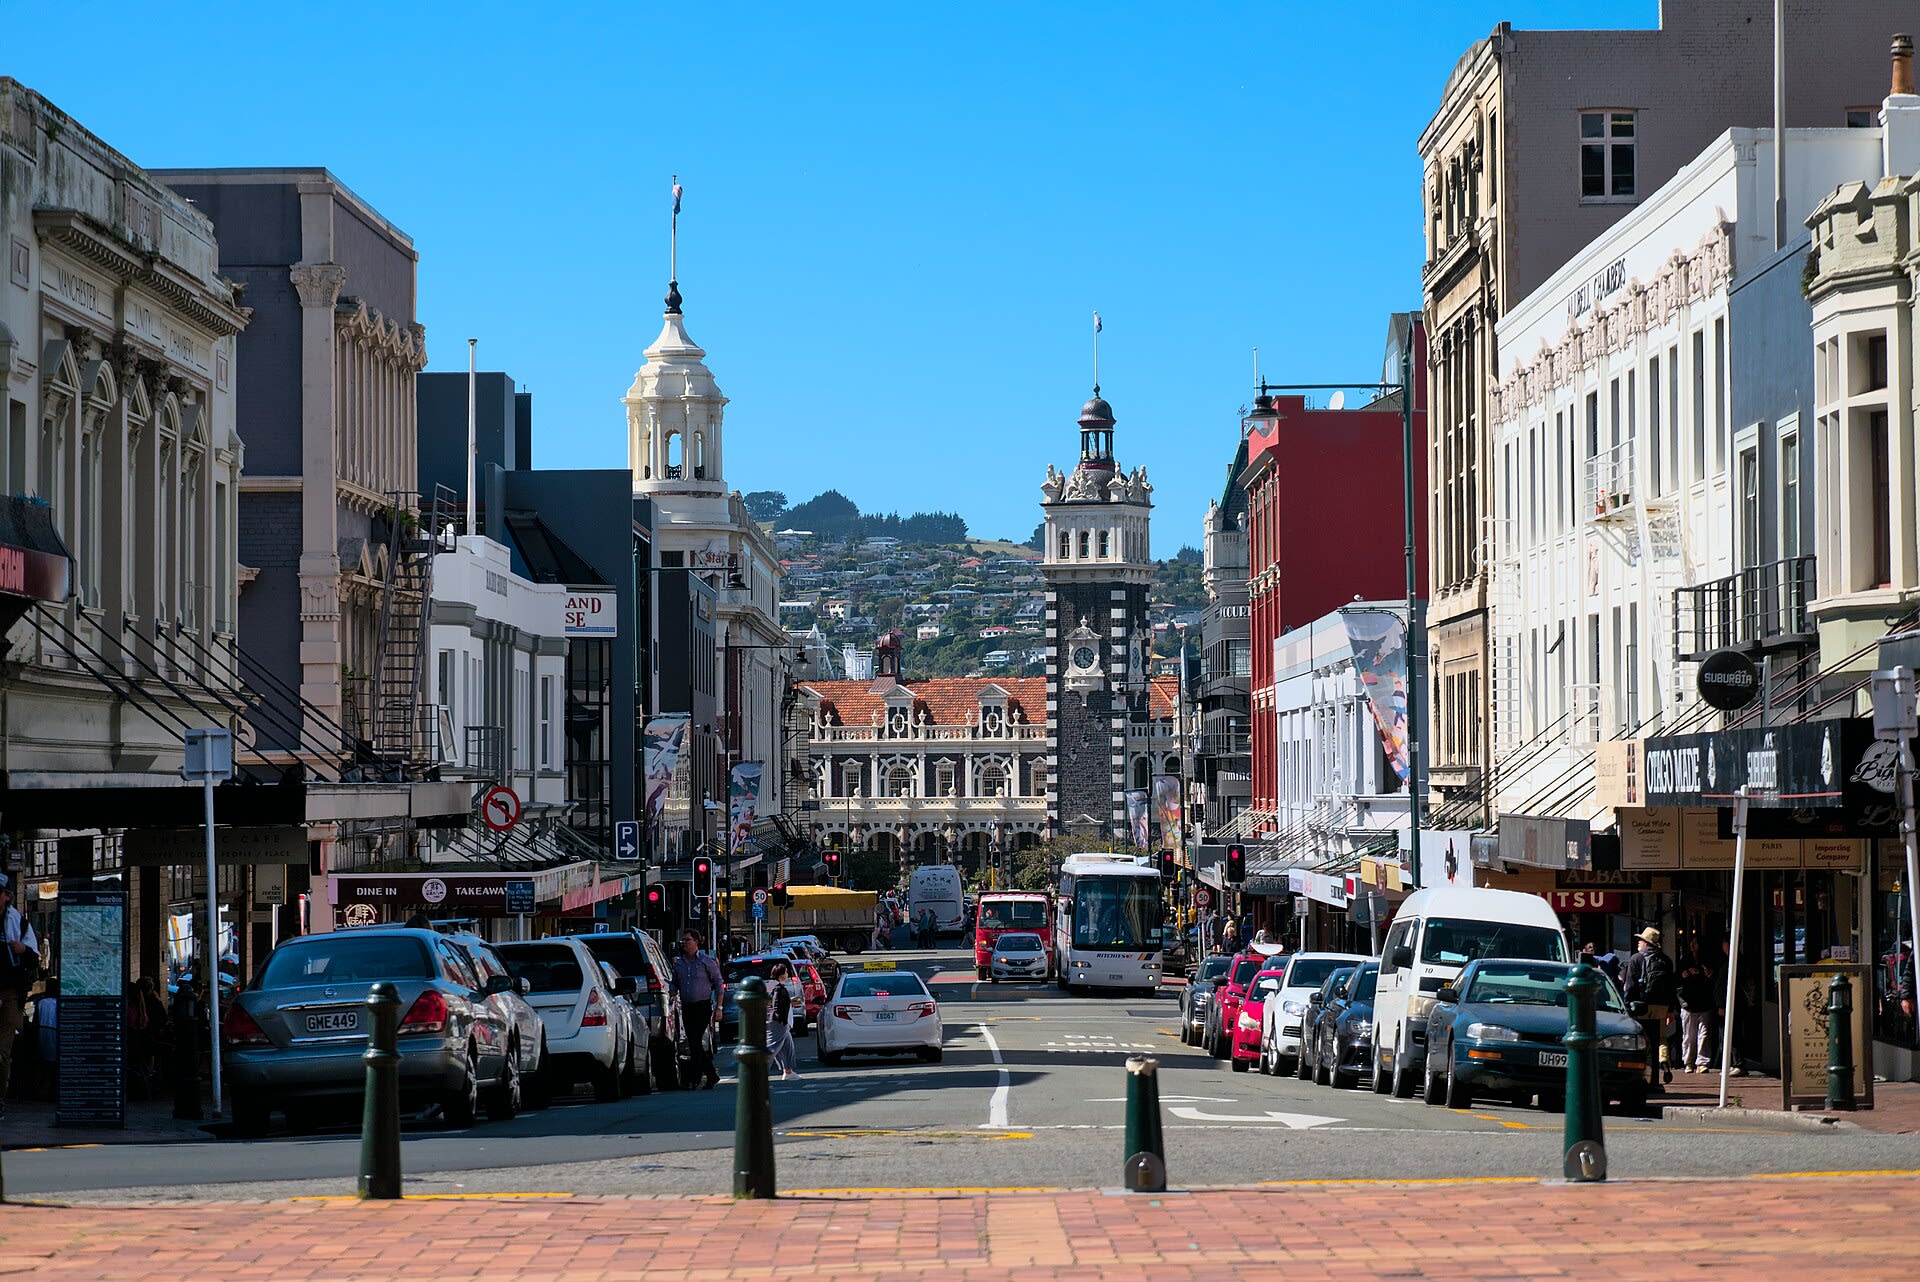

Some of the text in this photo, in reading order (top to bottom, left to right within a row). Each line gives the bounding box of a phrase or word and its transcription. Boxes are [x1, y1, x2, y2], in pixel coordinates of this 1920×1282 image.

[1594, 258, 1626, 301] CHAMBERS
[58, 266, 98, 313] MANCHESTER
[565, 597, 602, 614] AND
[1704, 672, 1752, 685] SUBURBIA
[1646, 752, 1674, 794] OTAGO
[1675, 747, 1701, 792] MADE
[1631, 820, 1670, 828] David Milne
[622, 826, 633, 839] P
[1638, 827, 1665, 835] Ceramics
[1761, 842, 1783, 850] PARIS
[1814, 843, 1851, 853] Importing
[1816, 852, 1851, 862] Company
[1565, 869, 1643, 884] ALBAR
[356, 887, 398, 896] DINE IN
[755, 892, 765, 901] 50
[1199, 893, 1208, 902] 50
[307, 1013, 357, 1030] GME449
[1541, 1054, 1568, 1066] UH99
